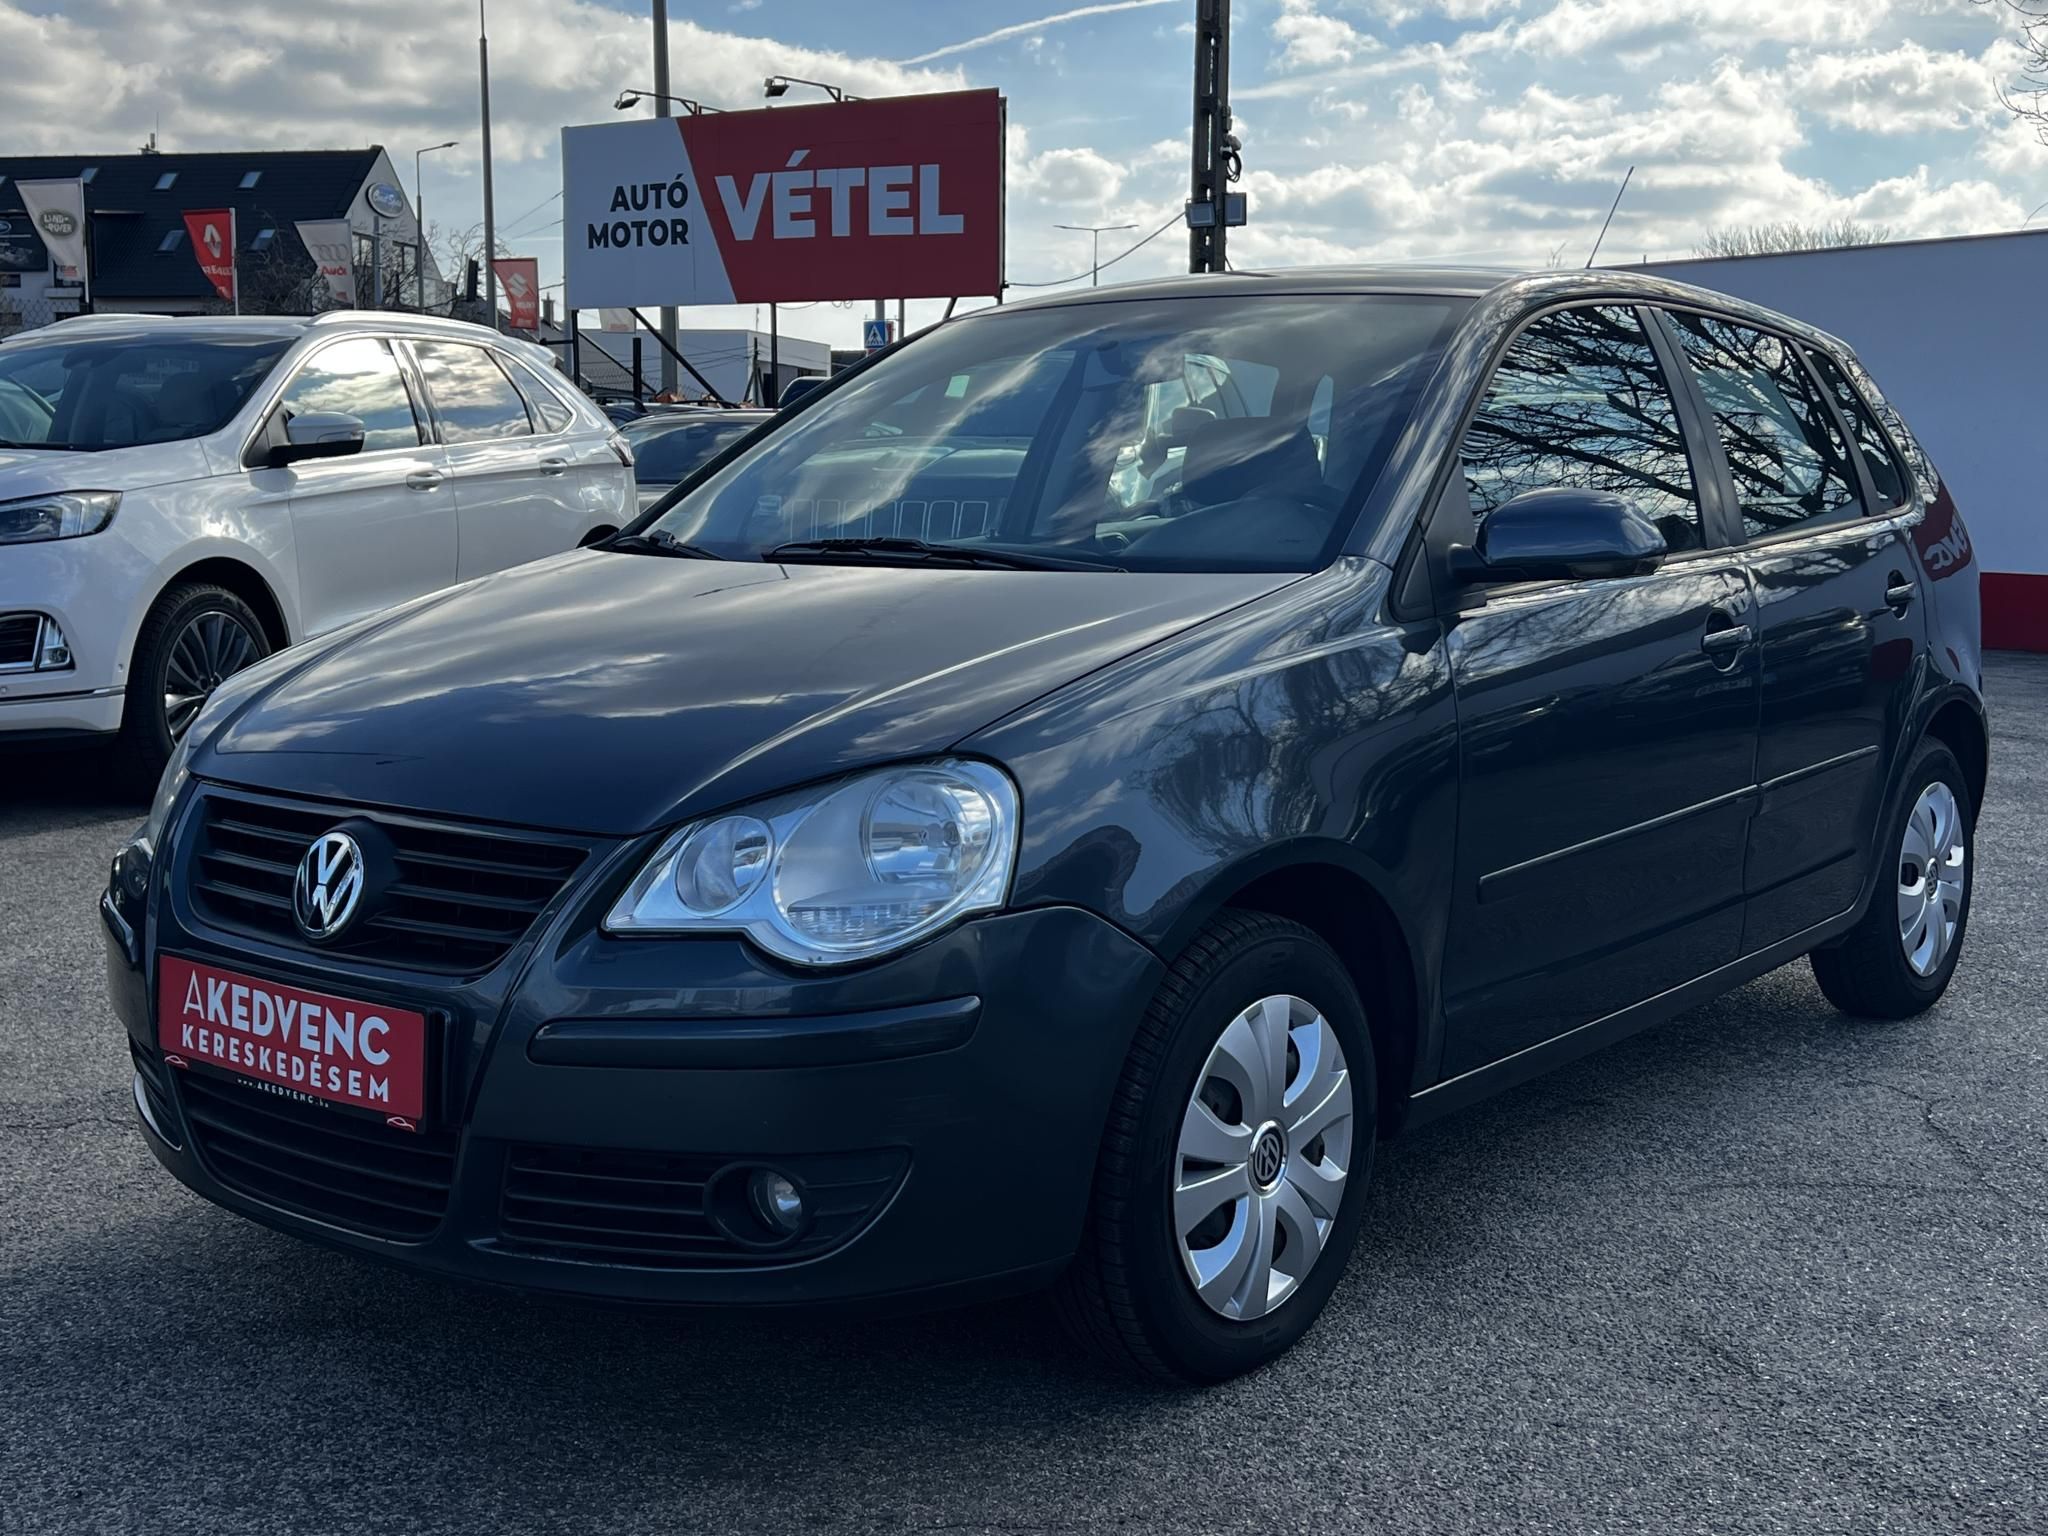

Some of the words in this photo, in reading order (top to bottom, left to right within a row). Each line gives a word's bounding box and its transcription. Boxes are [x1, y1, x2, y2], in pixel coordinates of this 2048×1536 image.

[610, 174, 689, 212] AUTÓ
[714, 149, 964, 241] VÉTEL
[588, 218, 689, 249] MOTOR
[183, 969, 391, 1066] AKEDVENC
[182, 1023, 390, 1103] KERESKEDÉSEM
